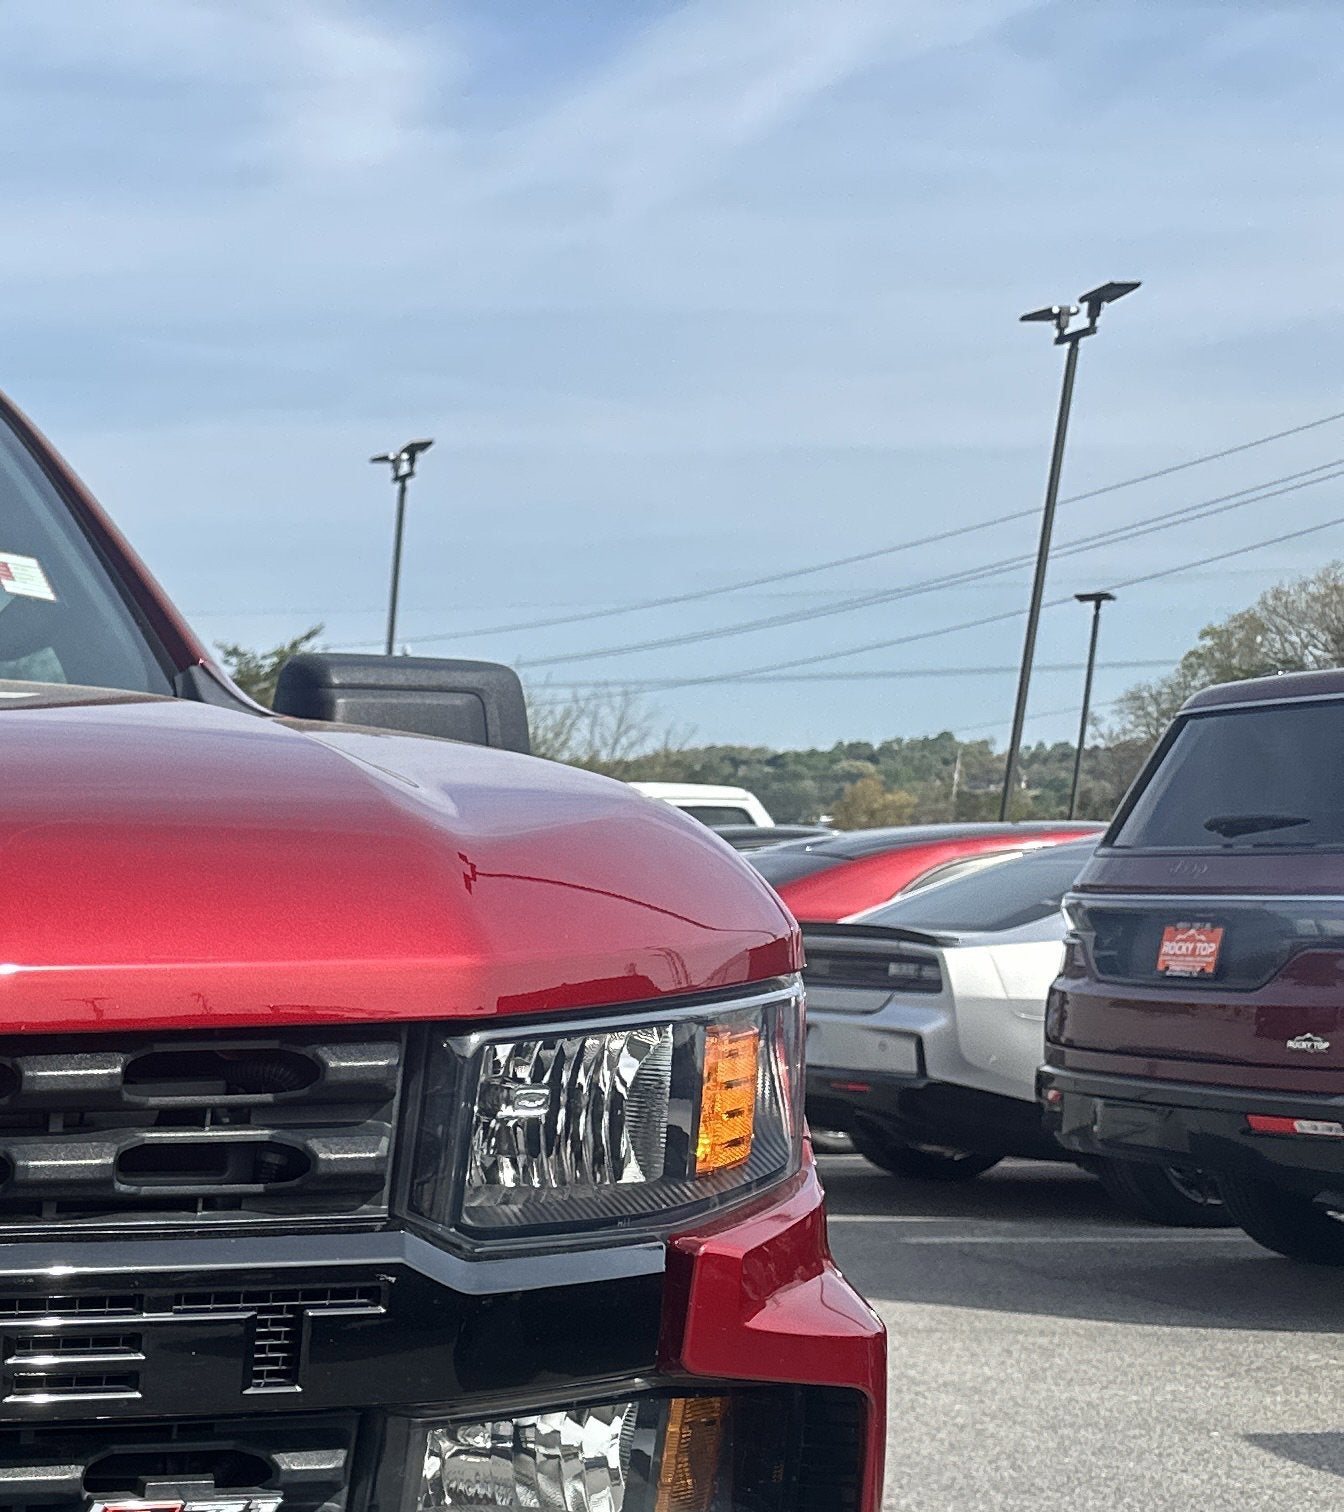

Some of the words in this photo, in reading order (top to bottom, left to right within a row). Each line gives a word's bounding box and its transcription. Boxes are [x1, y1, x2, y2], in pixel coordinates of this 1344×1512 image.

[1162, 941, 1194, 955] ROCKY
[1195, 942, 1216, 956] TOP
[1312, 1041, 1330, 1051] TOP
